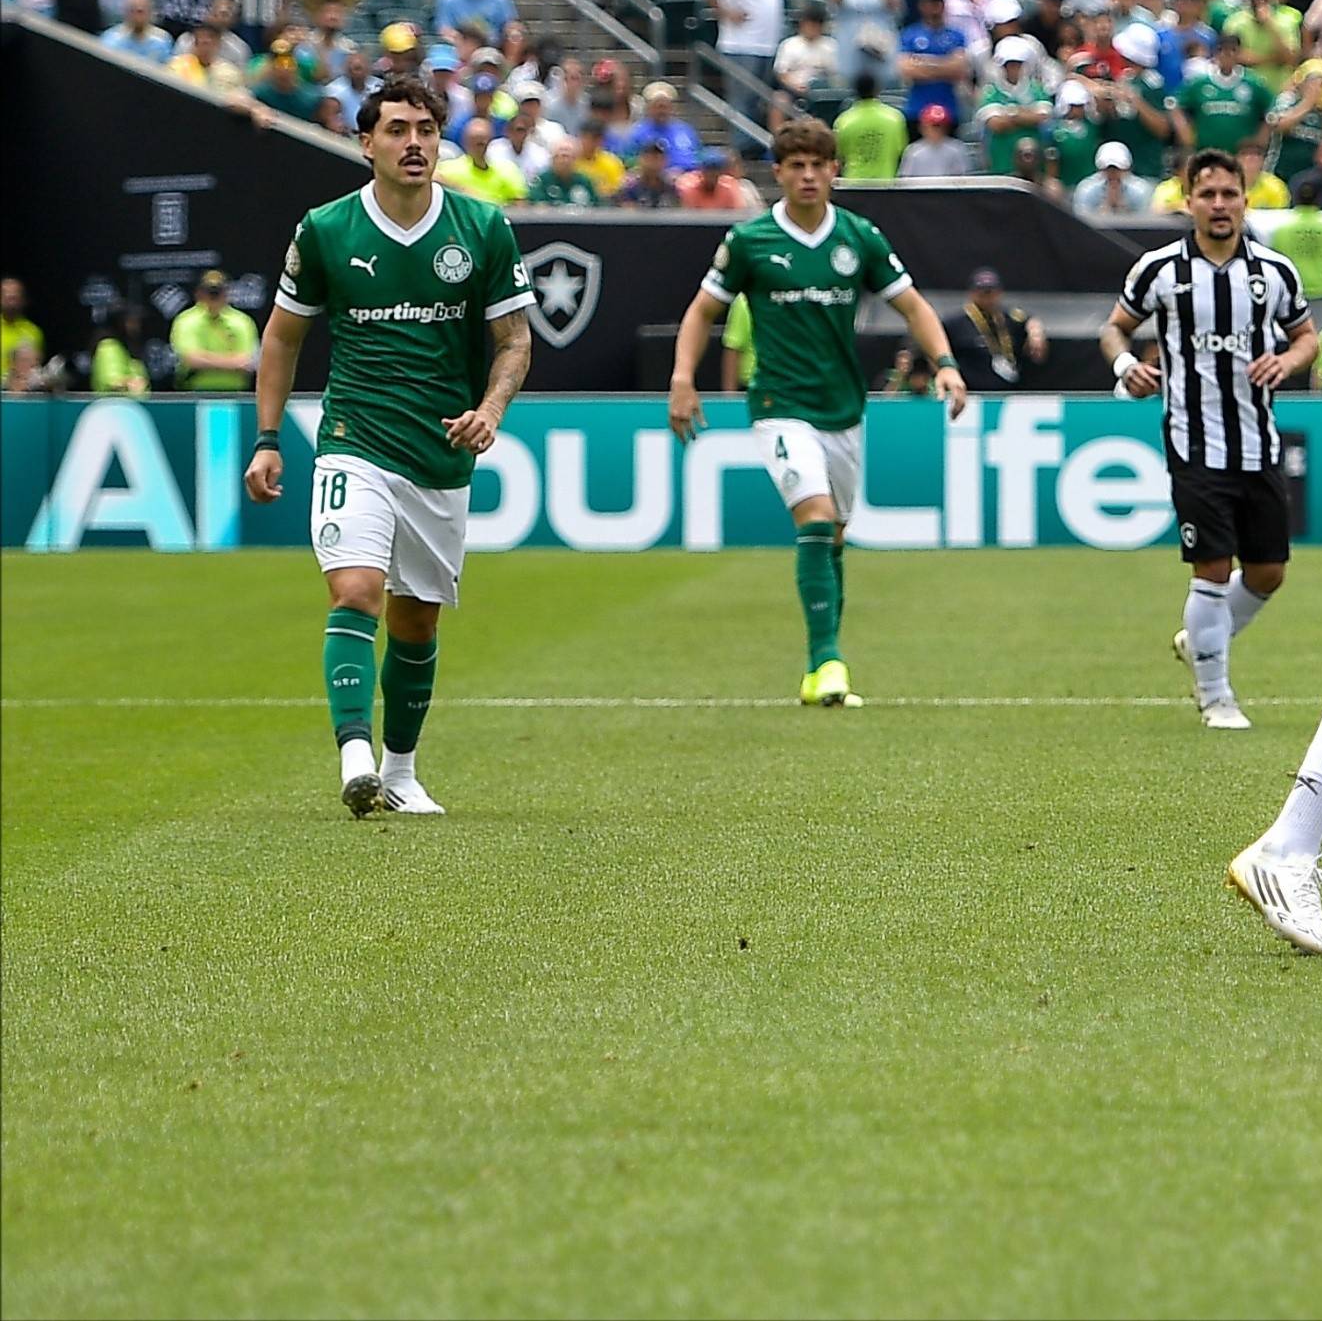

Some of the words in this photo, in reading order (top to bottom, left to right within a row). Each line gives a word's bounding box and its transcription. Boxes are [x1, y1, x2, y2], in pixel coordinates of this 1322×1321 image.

[349, 301, 467, 324] sportingbet
[775, 435, 788, 460] 4
[25, 398, 241, 553] AI
[319, 471, 348, 514] 18
